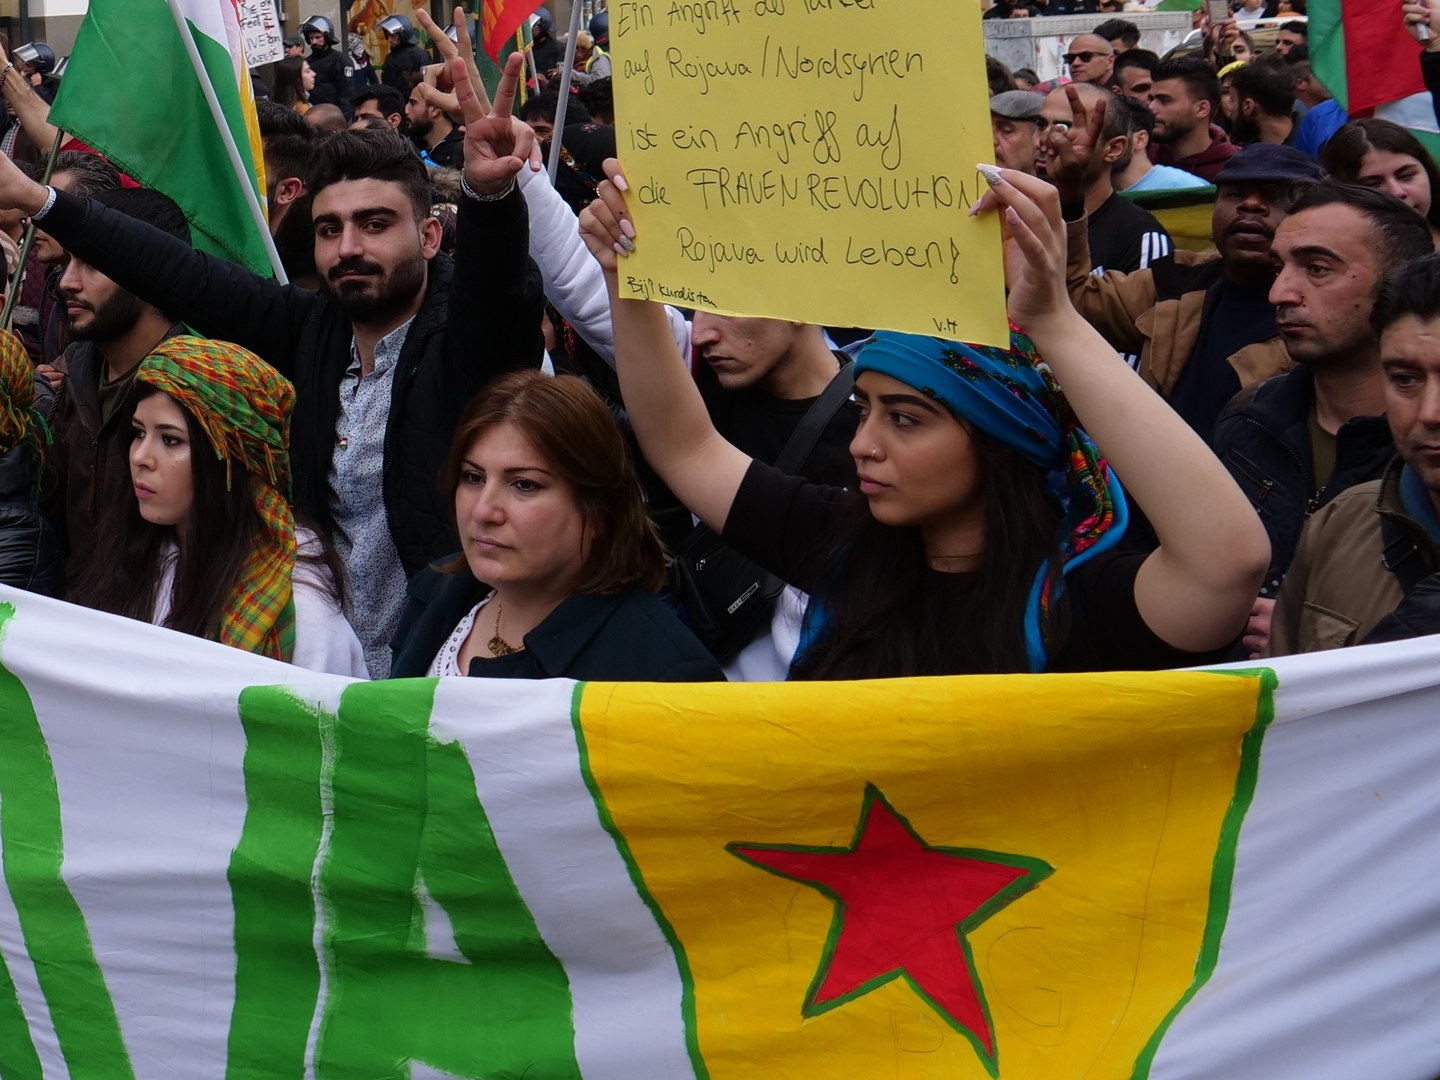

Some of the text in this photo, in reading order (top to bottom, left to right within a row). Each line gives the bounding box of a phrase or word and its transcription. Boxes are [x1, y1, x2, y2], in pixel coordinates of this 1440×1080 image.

[623, 49, 656, 95] auf
[630, 104, 903, 170] ist ein Angriff auf
[638, 177, 671, 205] die
[677, 226, 764, 273] Rojava
[775, 236, 829, 266] wird
